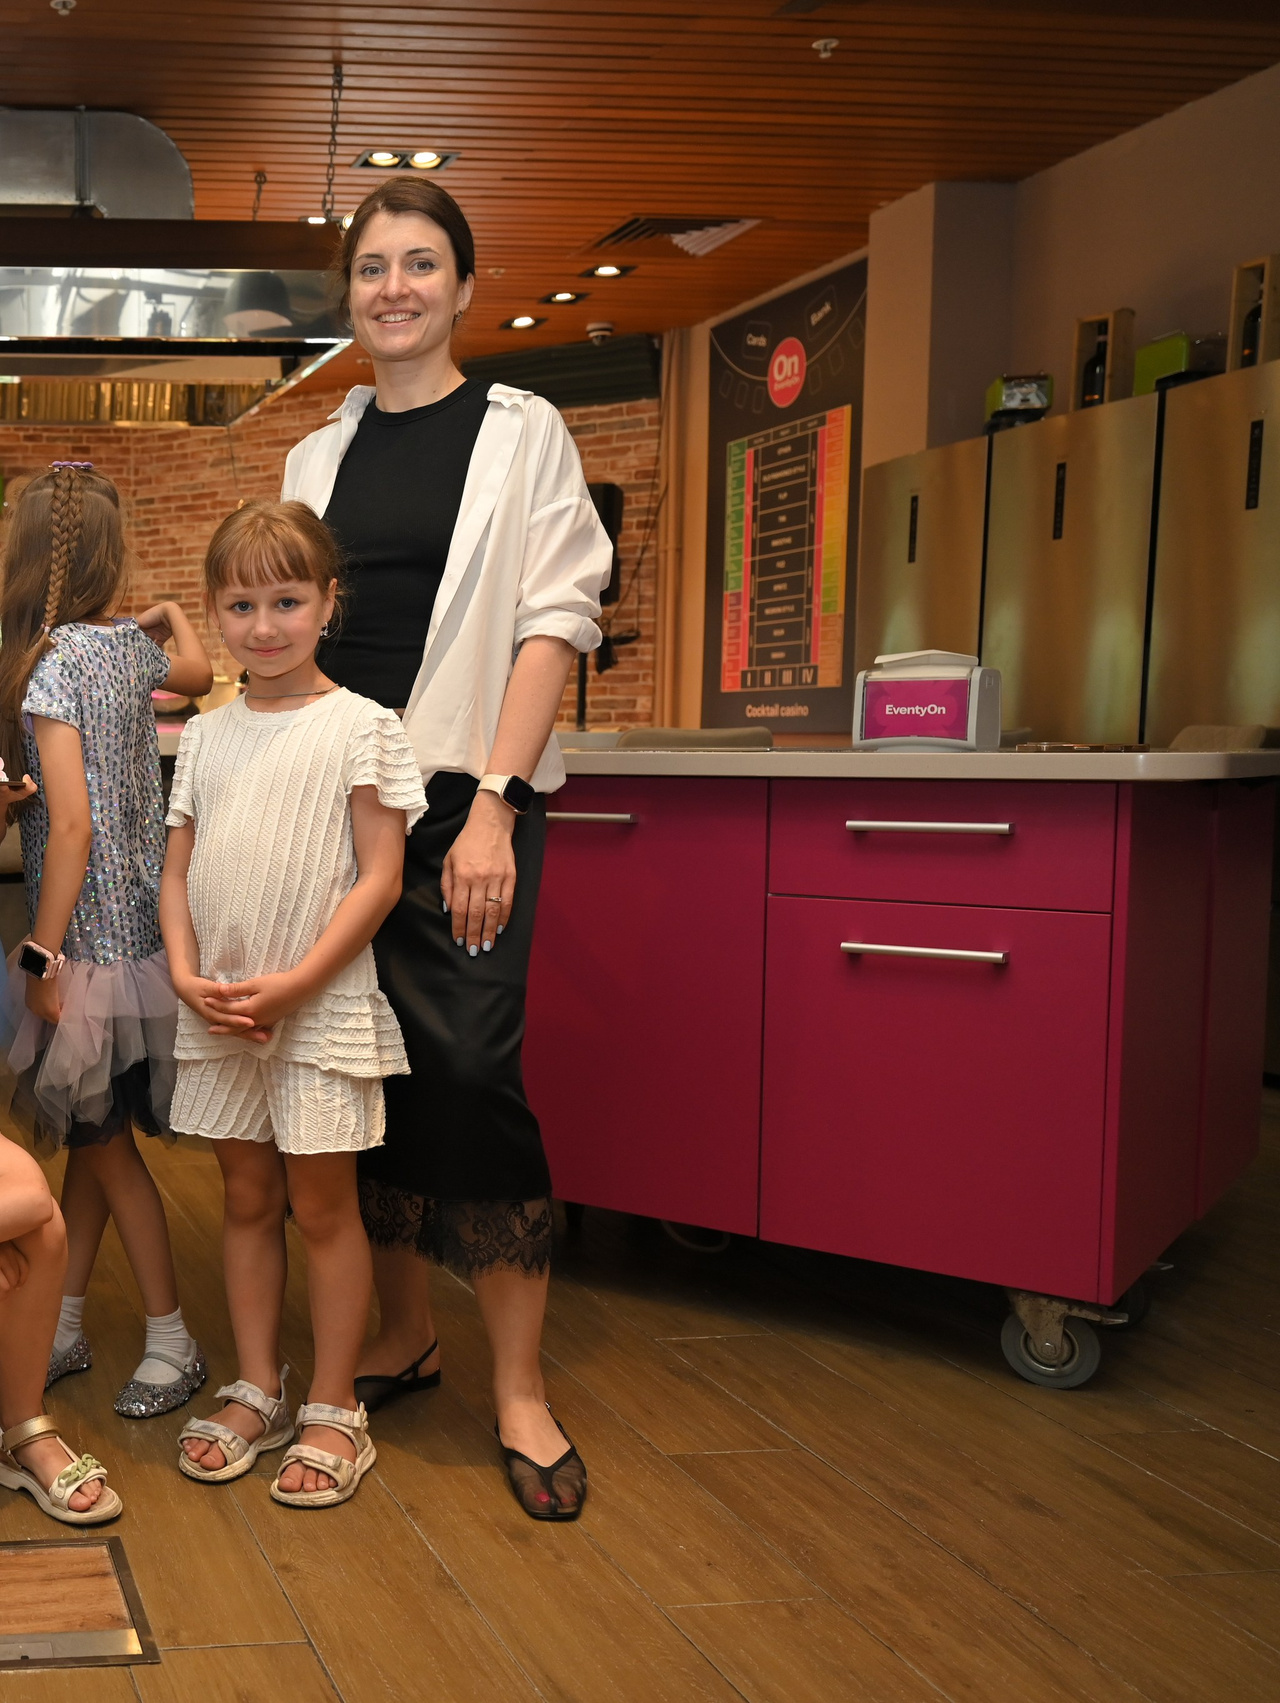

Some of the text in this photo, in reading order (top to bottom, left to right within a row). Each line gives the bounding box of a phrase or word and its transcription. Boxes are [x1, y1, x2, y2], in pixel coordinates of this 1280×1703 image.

[773, 354, 799, 381] On
[745, 702, 809, 718] Cocktail casino
[885, 704, 946, 717] EventyOn
